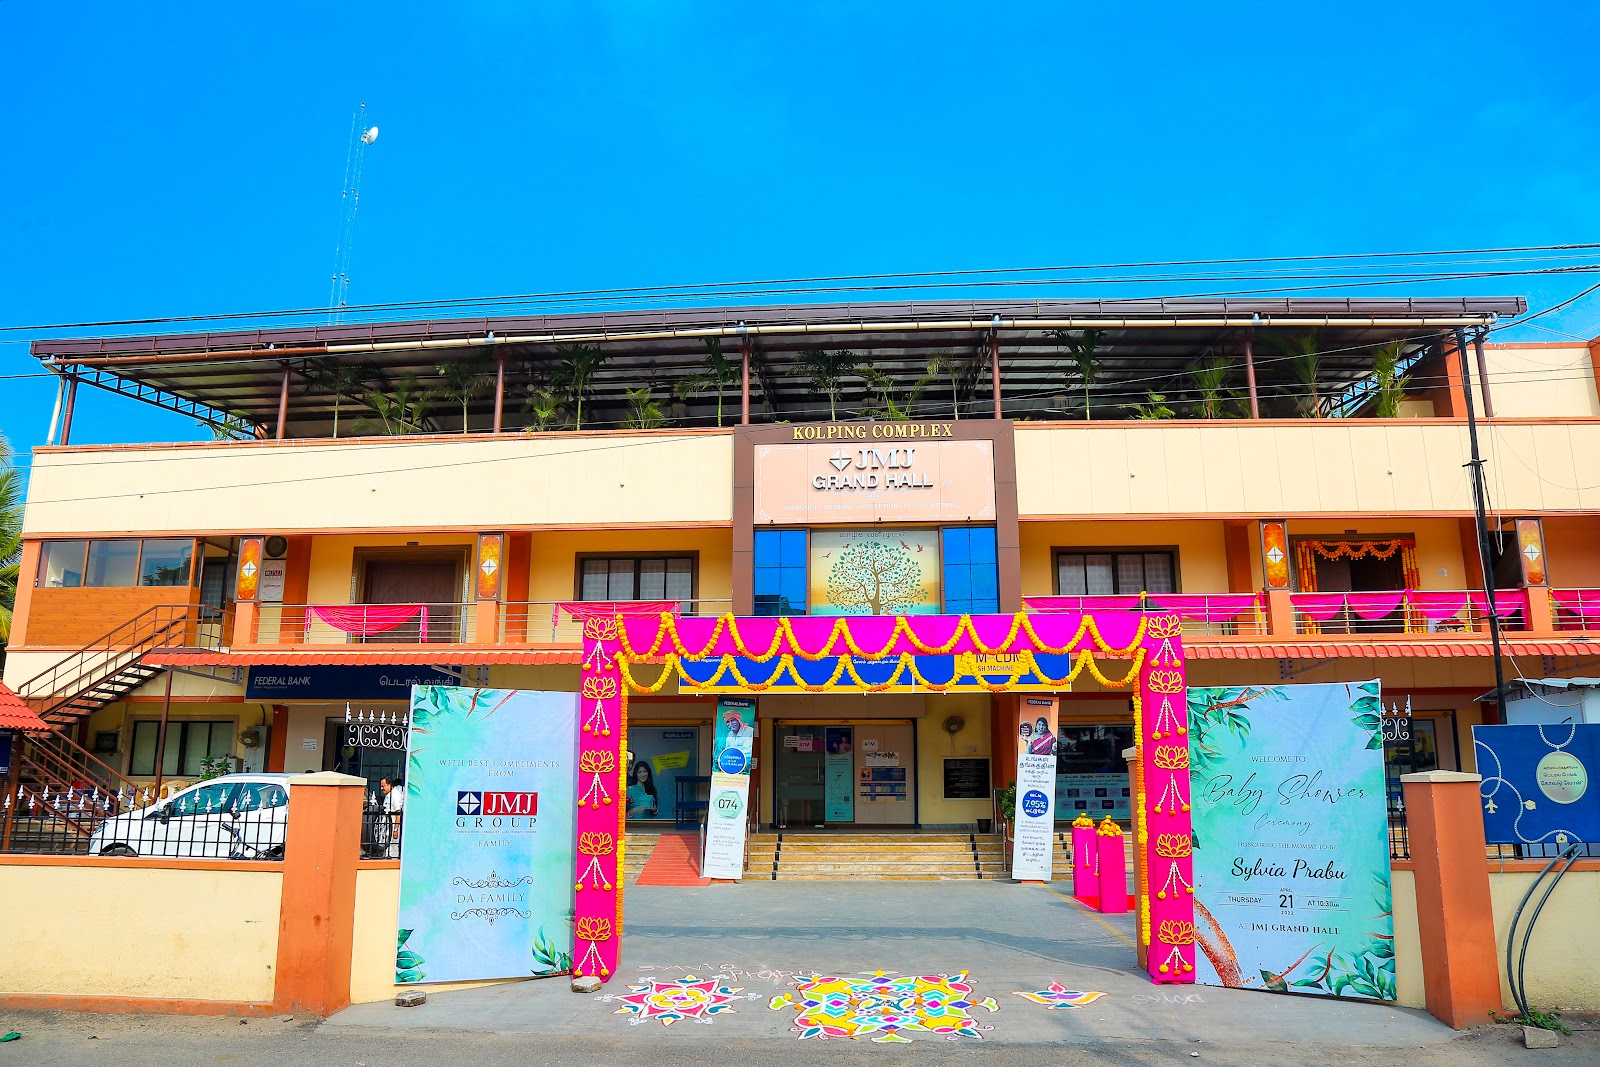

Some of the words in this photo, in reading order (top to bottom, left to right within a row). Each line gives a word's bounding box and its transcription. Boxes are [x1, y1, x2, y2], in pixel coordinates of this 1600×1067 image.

[793, 425, 867, 440] KOLPING
[872, 423, 953, 438] COMPLEX
[855, 448, 915, 470] JMJ
[812, 473, 879, 490] GRAND
[885, 472, 933, 488] HALL
[254, 676, 286, 685] FEDERAL
[287, 676, 311, 685] BANK
[439, 759, 464, 767] WITH
[468, 759, 490, 767] BEST
[493, 760, 560, 768] COMPLIMENTS
[1251, 755, 1292, 763] WELCOME
[1293, 755, 1306, 763] TO
[1203, 772, 1270, 816] Baby
[1277, 769, 1372, 806] Shower
[487, 793, 534, 814] JMJ
[718, 798, 738, 810] 074
[1025, 799, 1046, 809] 7.95%
[455, 816, 537, 828] GROUP
[1253, 813, 1315, 836] Ceremony
[1237, 841, 1277, 849] HONOURING
[1231, 856, 1287, 881] Sylvia
[1292, 858, 1348, 880] Prabu
[457, 893, 475, 904] DA
[479, 892, 526, 903] FAMILY
[1227, 895, 1262, 903] THURSDAY
[1279, 894, 1293, 908] 21
[1251, 923, 1268, 932] JMJ
[1271, 924, 1309, 933] GRAND
[1313, 926, 1341, 935] HALL
